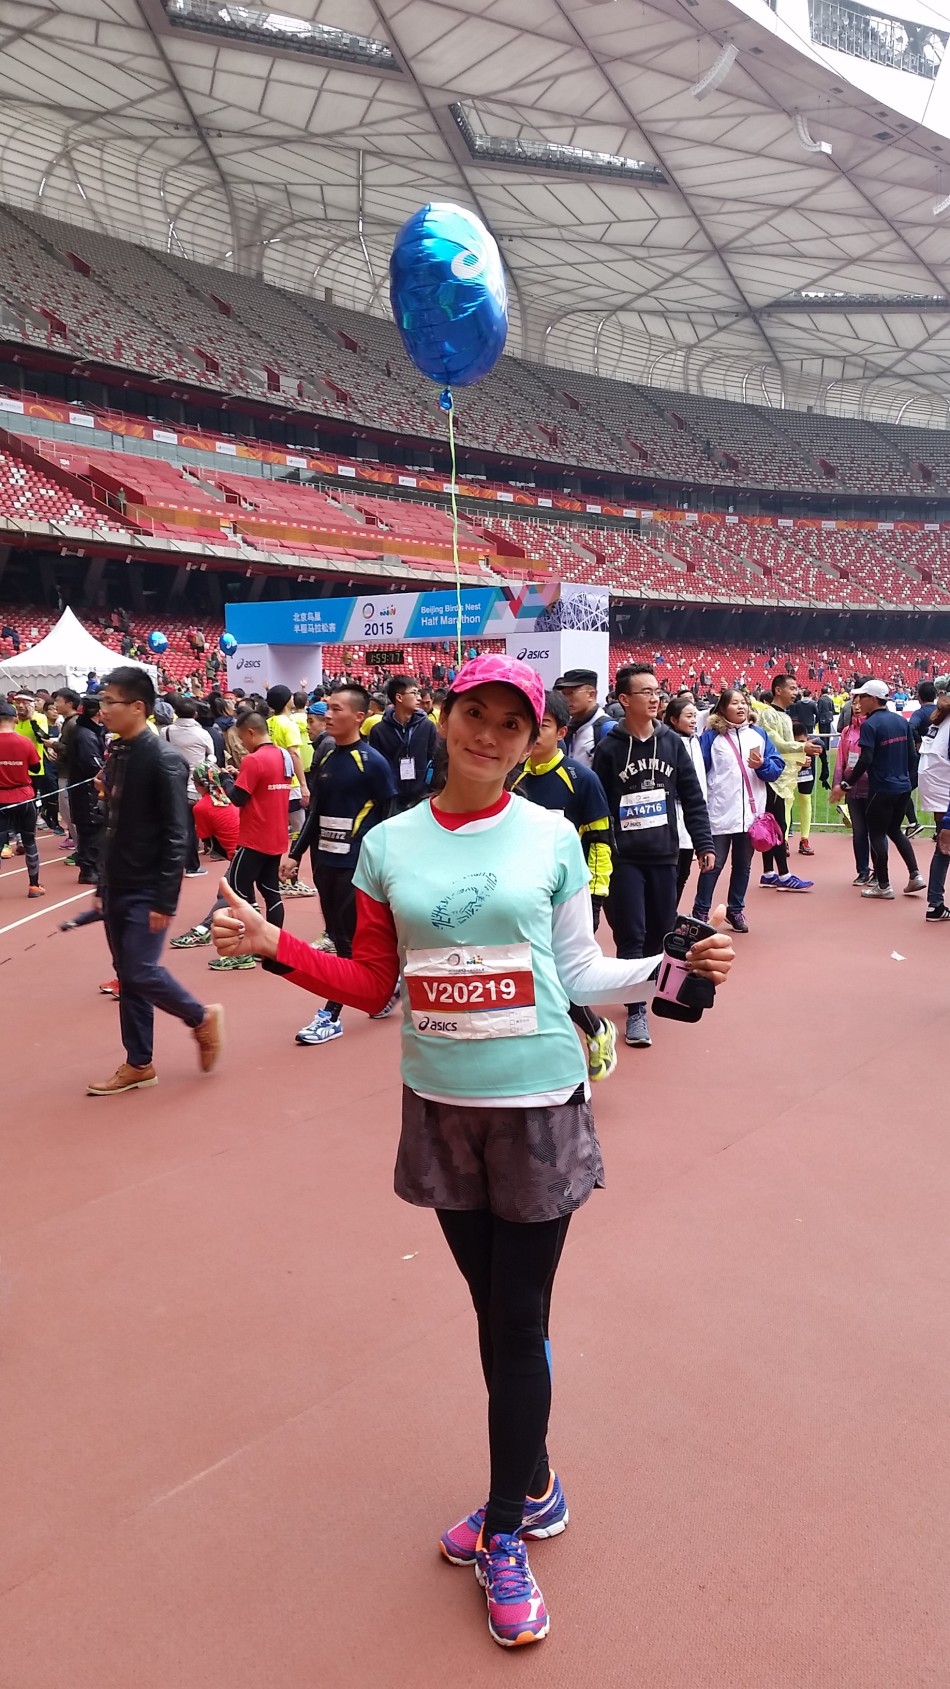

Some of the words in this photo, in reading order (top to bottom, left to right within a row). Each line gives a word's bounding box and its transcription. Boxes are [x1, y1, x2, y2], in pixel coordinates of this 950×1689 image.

[420, 606, 443, 615] Beijing
[444, 604, 464, 612] Birds
[465, 603, 481, 611] Nest
[421, 616, 438, 626] Half
[364, 622, 394, 636] 2015
[619, 758, 674, 783] RENMIN
[626, 803, 662, 817] A14716
[422, 978, 516, 1004] V20219
